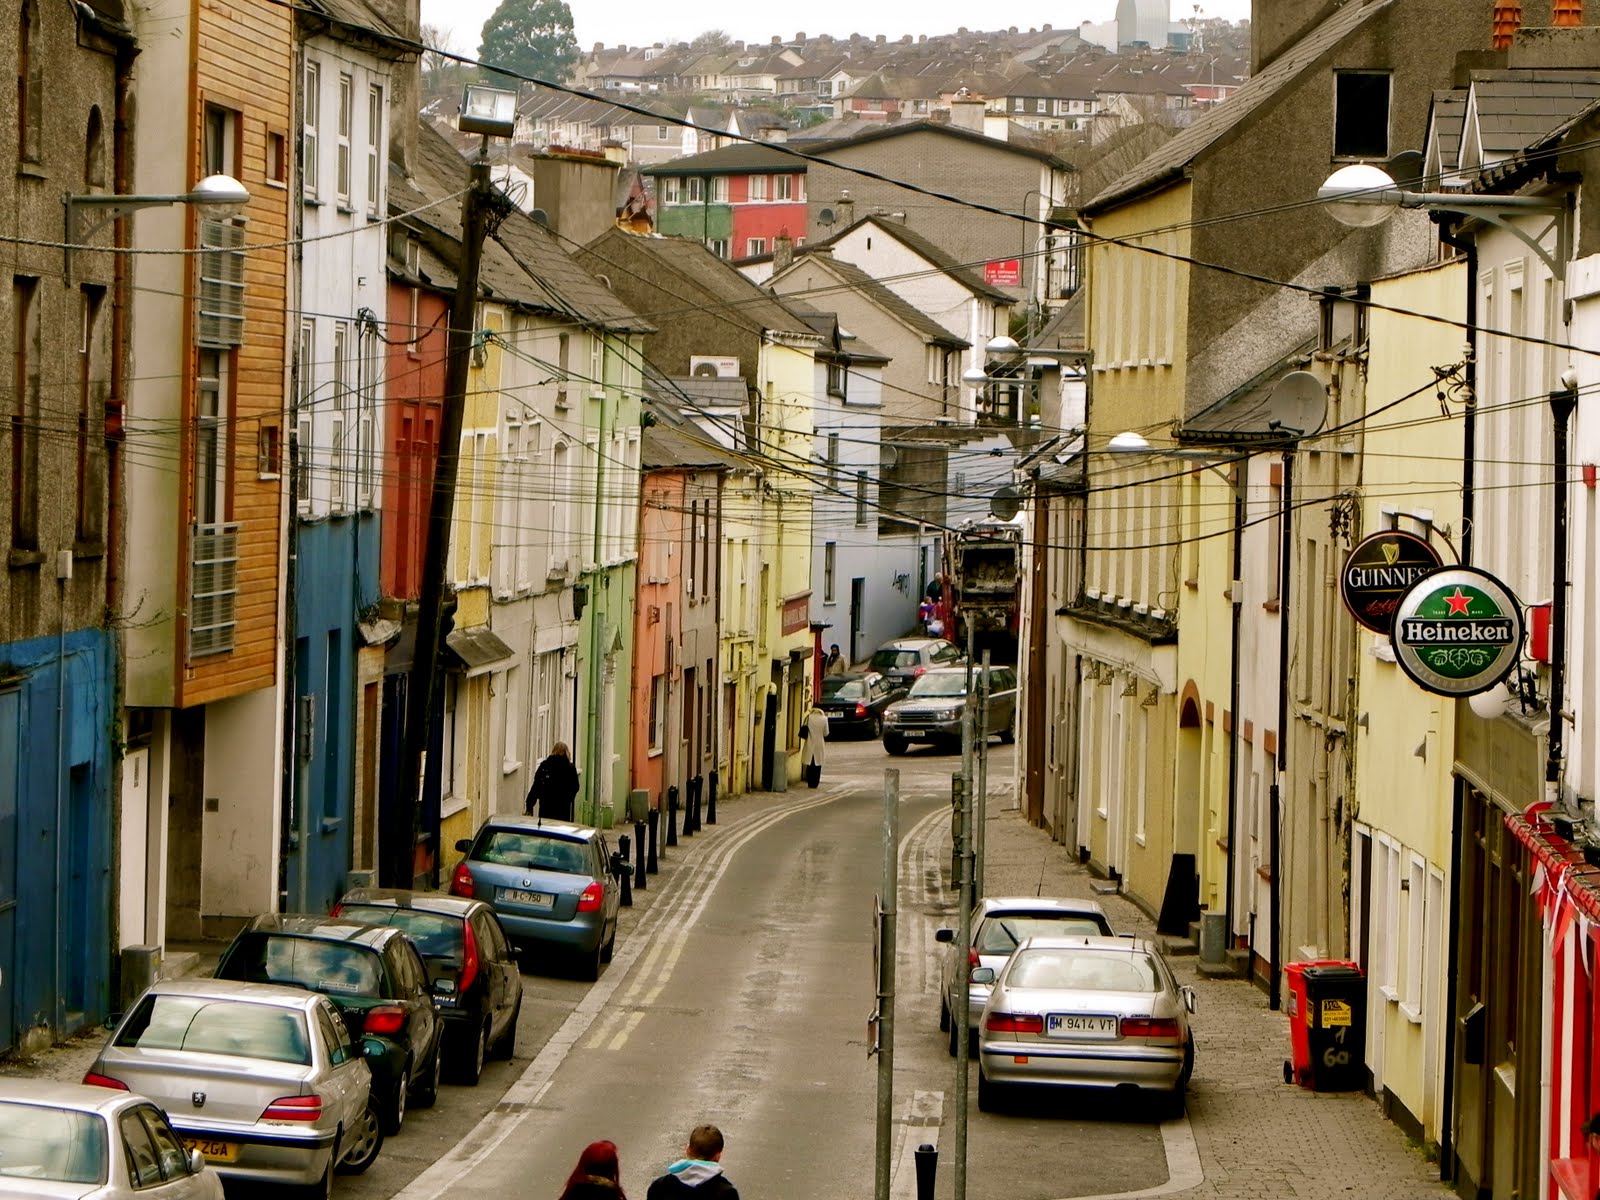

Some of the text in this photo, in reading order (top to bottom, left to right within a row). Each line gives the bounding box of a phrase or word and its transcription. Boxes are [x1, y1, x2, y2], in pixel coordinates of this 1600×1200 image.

[1407, 622, 1509, 641] Heineken
[1055, 1018, 1113, 1031] M 9414 VT
[201, 1141, 228, 1156] ZGA
